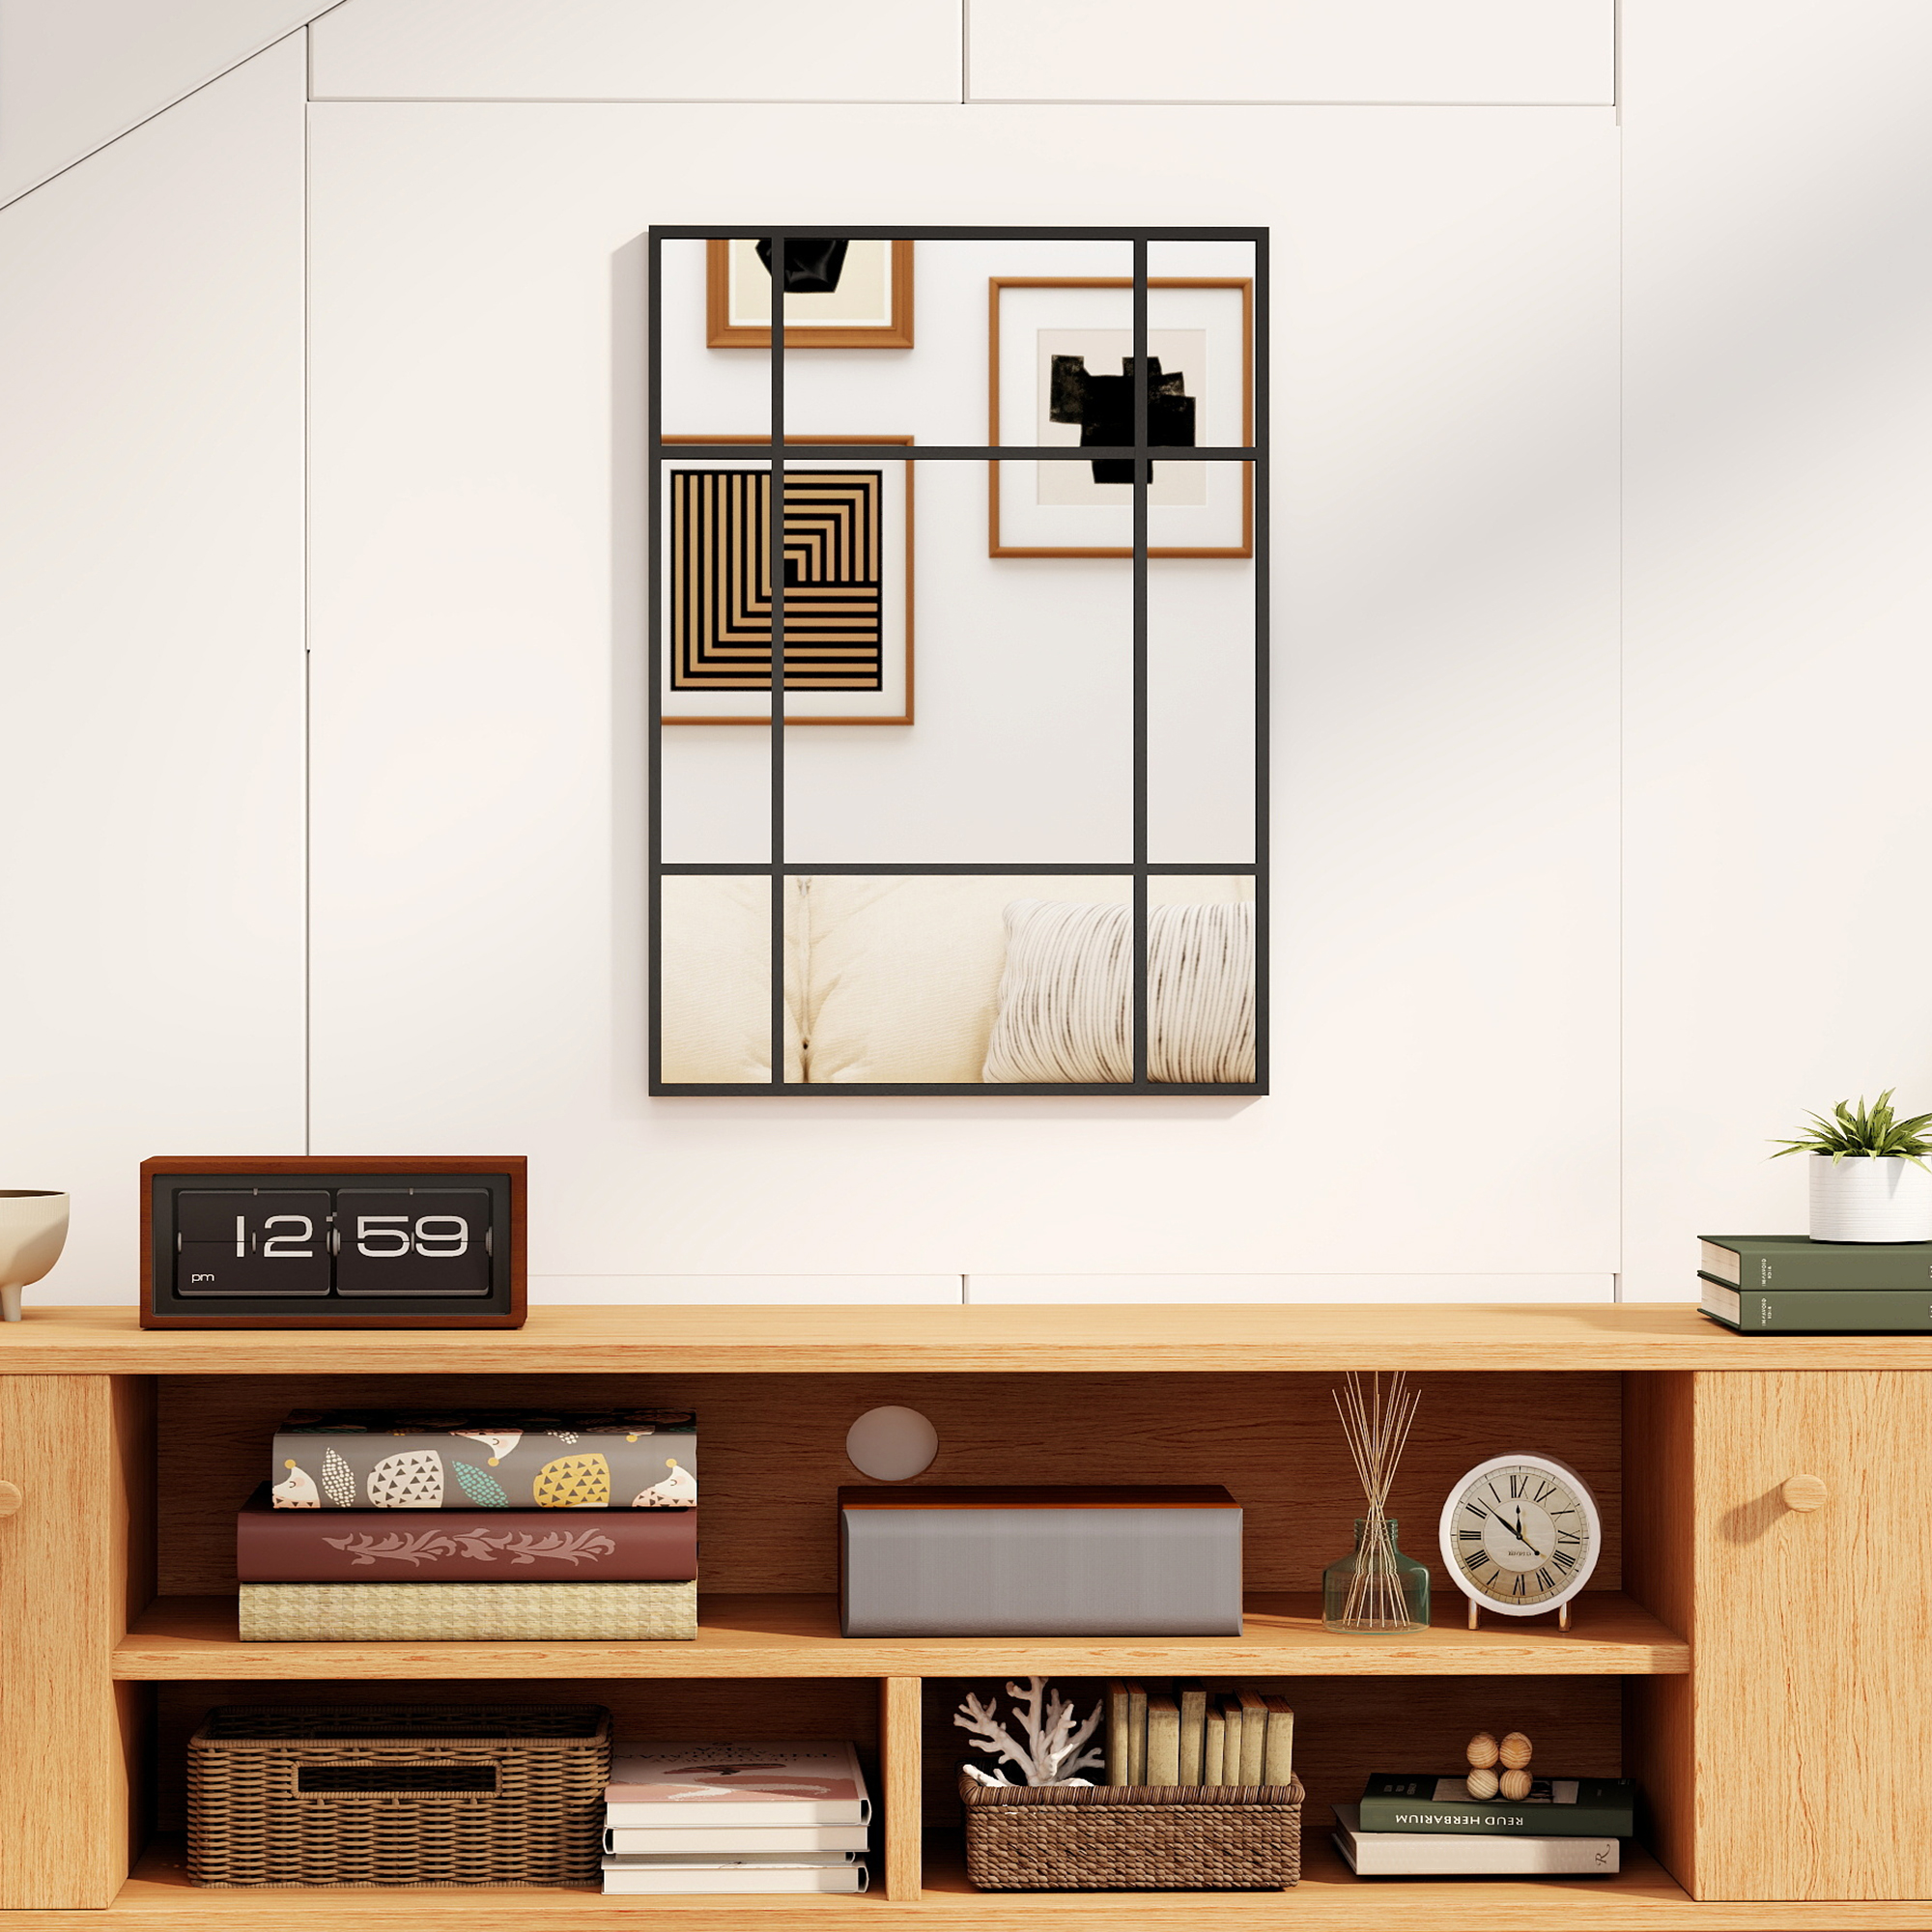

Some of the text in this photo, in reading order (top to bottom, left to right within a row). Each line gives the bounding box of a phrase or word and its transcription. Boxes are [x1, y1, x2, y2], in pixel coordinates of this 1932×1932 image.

[237, 1215, 469, 1258] 12 59
[191, 1273, 214, 1284] pm
[1395, 1814, 1523, 1826] REUD HERBARIUM
[1595, 1843, 1611, 1866] R
